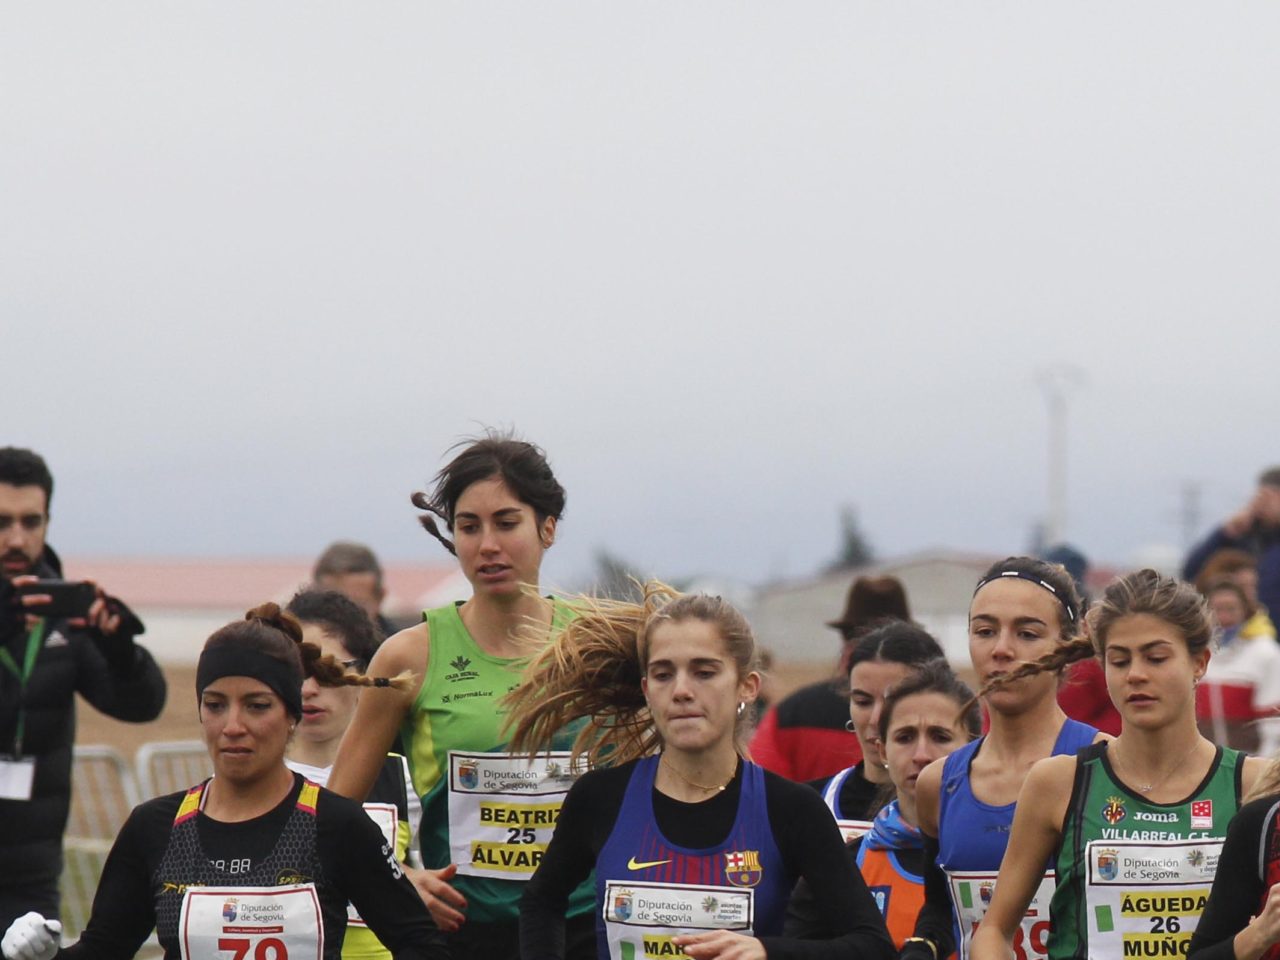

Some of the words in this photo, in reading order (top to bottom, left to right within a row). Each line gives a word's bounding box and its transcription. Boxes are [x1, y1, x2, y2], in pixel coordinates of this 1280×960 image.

[483, 768, 538, 780] Diputación
[483, 780, 497, 789] de
[499, 781, 538, 790] Segovia
[507, 828, 536, 845] 25
[1102, 828, 1181, 841] VILLARREAL
[1124, 857, 1179, 868] Diputación
[1124, 869, 1139, 879] de
[1140, 870, 1179, 881] Segovia
[240, 903, 283, 914] Diputación
[638, 900, 692, 912] Diputación
[1121, 895, 1206, 913] ÁGUEDA
[240, 913, 252, 922] de
[252, 914, 285, 923] Segovia
[637, 911, 650, 921] de
[652, 912, 692, 924] Segovia
[1150, 916, 1181, 934] 26
